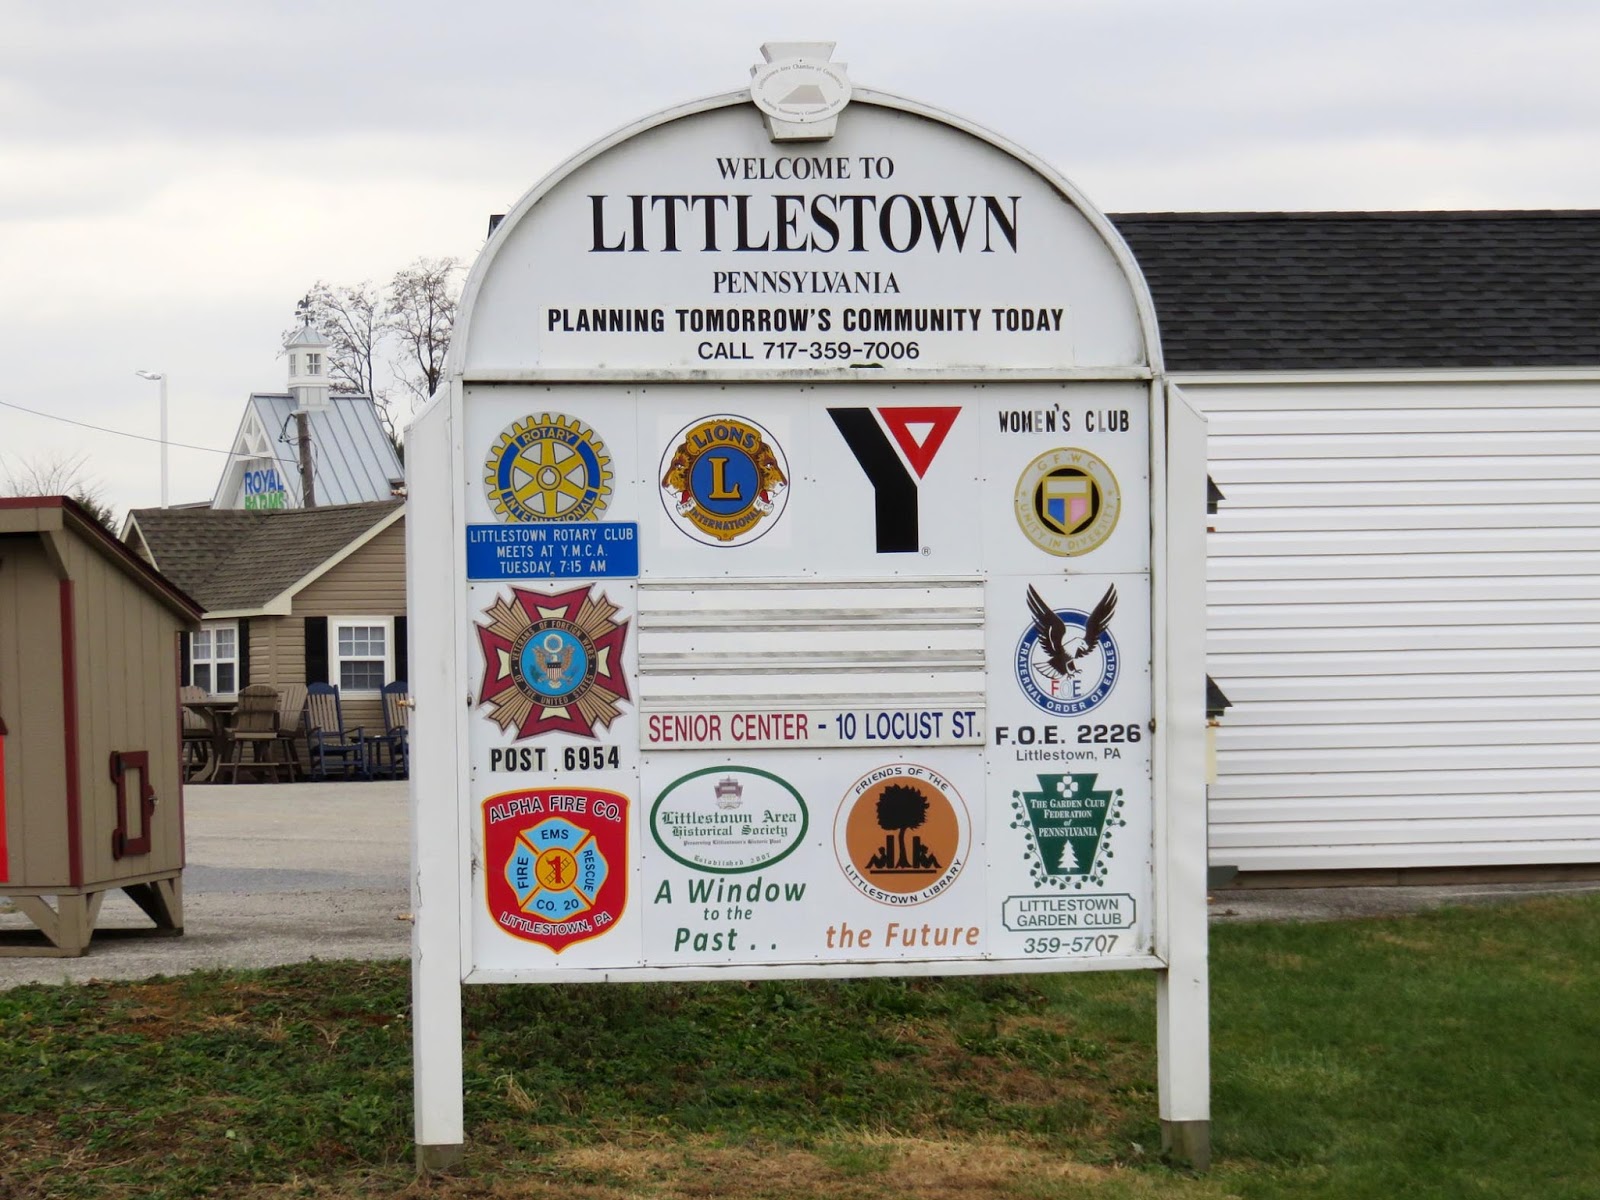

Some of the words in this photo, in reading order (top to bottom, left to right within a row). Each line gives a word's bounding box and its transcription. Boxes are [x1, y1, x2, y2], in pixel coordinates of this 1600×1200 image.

[716, 157, 851, 180] WELCOME
[859, 157, 894, 180] TO
[587, 194, 1022, 254] LITTLESTOWN
[712, 271, 901, 294] PENNSYLVANIA
[548, 309, 665, 333] PLANNING
[675, 308, 832, 332] TOMORROW'S
[843, 308, 981, 332] COMMUNITY
[992, 308, 1064, 332] TODAY
[698, 341, 754, 360] CALL
[762, 341, 920, 360] 717-359-7006
[999, 403, 1072, 433] WOMEN'S
[1085, 410, 1130, 433] CLUB
[522, 427, 575, 445] ROTARY
[692, 425, 756, 449] LIONS
[244, 469, 284, 495] ROYAL
[708, 457, 742, 500] L
[826, 406, 963, 554] Y
[504, 496, 596, 523] INTERIONAL
[690, 507, 763, 531] INTERNATIONAL
[470, 529, 547, 543] LITTLESTOWN
[553, 528, 597, 542] ROTARY
[604, 527, 634, 541] CLUB
[1020, 503, 1046, 539] UNITY
[1050, 538, 1062, 548] IN
[497, 546, 534, 558] MEETS
[540, 545, 554, 557] AT
[561, 544, 608, 557] Y.M.C.A.
[500, 561, 551, 574] TUESDAY
[560, 560, 582, 573] 7:15
[589, 560, 607, 572] AM
[512, 627, 536, 661] VETERANS
[538, 622, 548, 630] OF
[552, 620, 583, 637] FOREIGN
[582, 637, 596, 660] WARS
[1018, 641, 1044, 703] FRATERNAL
[1046, 701, 1087, 713] ORDER
[1091, 689, 1106, 703] OF
[1103, 640, 1116, 686] EAGLES
[514, 674, 524, 683] OF
[523, 685, 537, 700] THE
[541, 696, 569, 706] UNITED
[573, 674, 594, 699] STATES
[649, 713, 722, 743] SENIOR
[730, 713, 810, 742] CENTER
[835, 713, 857, 740] 10
[865, 711, 944, 740] LOCUST
[951, 711, 981, 739] ST.
[995, 725, 1066, 745] F.O.E.
[1077, 724, 1141, 744] 2226
[490, 747, 547, 772] POST
[564, 746, 620, 771] 6954
[1016, 748, 1098, 762] Littlestown,
[1104, 748, 1122, 760] PA
[855, 767, 902, 795] FRIENDS
[907, 767, 924, 776] OF
[928, 773, 949, 792] THE
[490, 796, 544, 824] ALPHA
[548, 795, 588, 813] FIRE
[592, 800, 622, 823] CO.
[1030, 799, 1048, 809] THE
[1050, 798, 1082, 808] GARDEN
[1084, 797, 1106, 808] CLUB
[1043, 809, 1092, 819] FEDERATION
[661, 811, 753, 825] Littlestown
[761, 809, 797, 824] Area
[1063, 819, 1072, 827] of
[541, 829, 569, 840] EMS
[672, 825, 733, 839] Historical
[741, 824, 789, 838] Society
[1038, 826, 1098, 837] PENNSYLVANIA
[516, 856, 529, 889] FIRE
[547, 855, 562, 884] 1
[583, 849, 596, 893] RESCUE
[653, 879, 672, 904] A
[687, 876, 807, 904] Window
[844, 864, 919, 905] LITTLESTOWN
[922, 859, 963, 899] LIBRARY
[536, 899, 557, 912] CO.
[563, 898, 580, 911] 20
[703, 907, 720, 921] to
[727, 905, 753, 921] the
[1019, 899, 1119, 912] LITTLESTOWN
[500, 911, 592, 936] LITTLESTOWN,
[593, 911, 613, 926] PA
[1016, 913, 1077, 927] GARDEN
[1083, 912, 1122, 926] CLUB
[825, 922, 873, 949] the
[884, 922, 980, 948] Future
[1023, 934, 1119, 954] 359-5707
